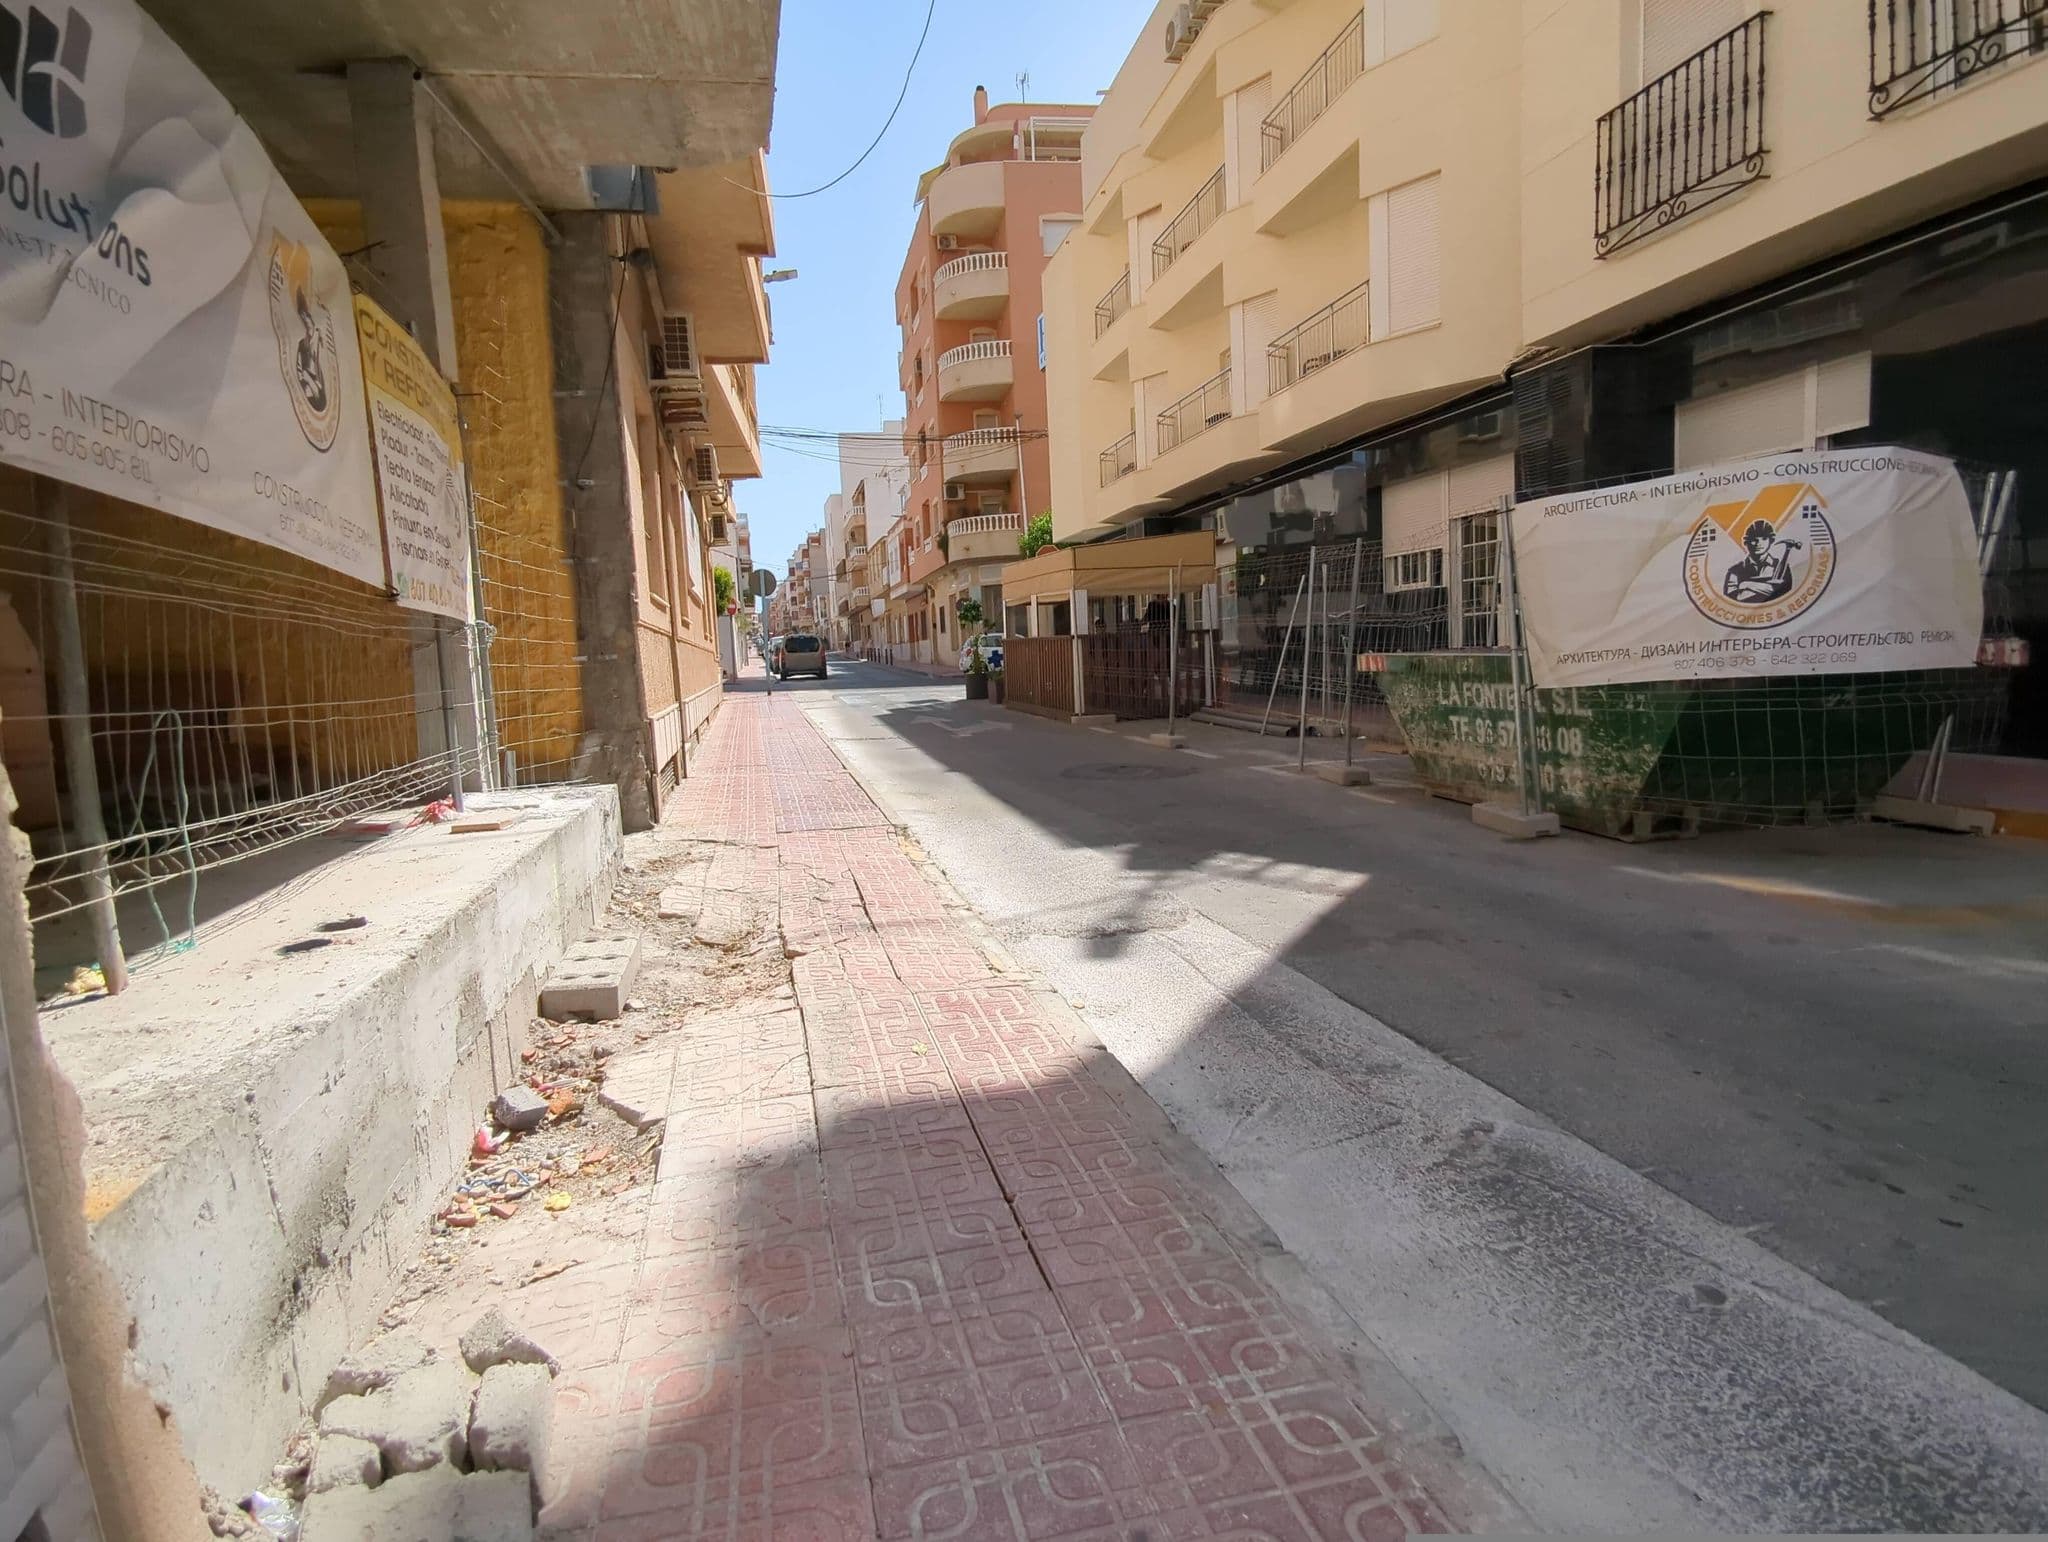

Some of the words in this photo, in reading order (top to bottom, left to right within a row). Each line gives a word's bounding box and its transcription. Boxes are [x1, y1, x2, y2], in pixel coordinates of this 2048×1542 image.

[52, 426, 88, 461] 605
[62, 387, 210, 473] INTERIORISMO
[1544, 490, 1639, 517] ARQUITECTURA
[1650, 469, 1759, 498] INTERIORISMO
[1689, 564, 1773, 624] CONSTRUCCIONES
[1788, 553, 1830, 614] REFORMAS
[1557, 648, 1631, 665] АРХИТЕКТУРА
[1641, 640, 1695, 659] ДИЗАЙН
